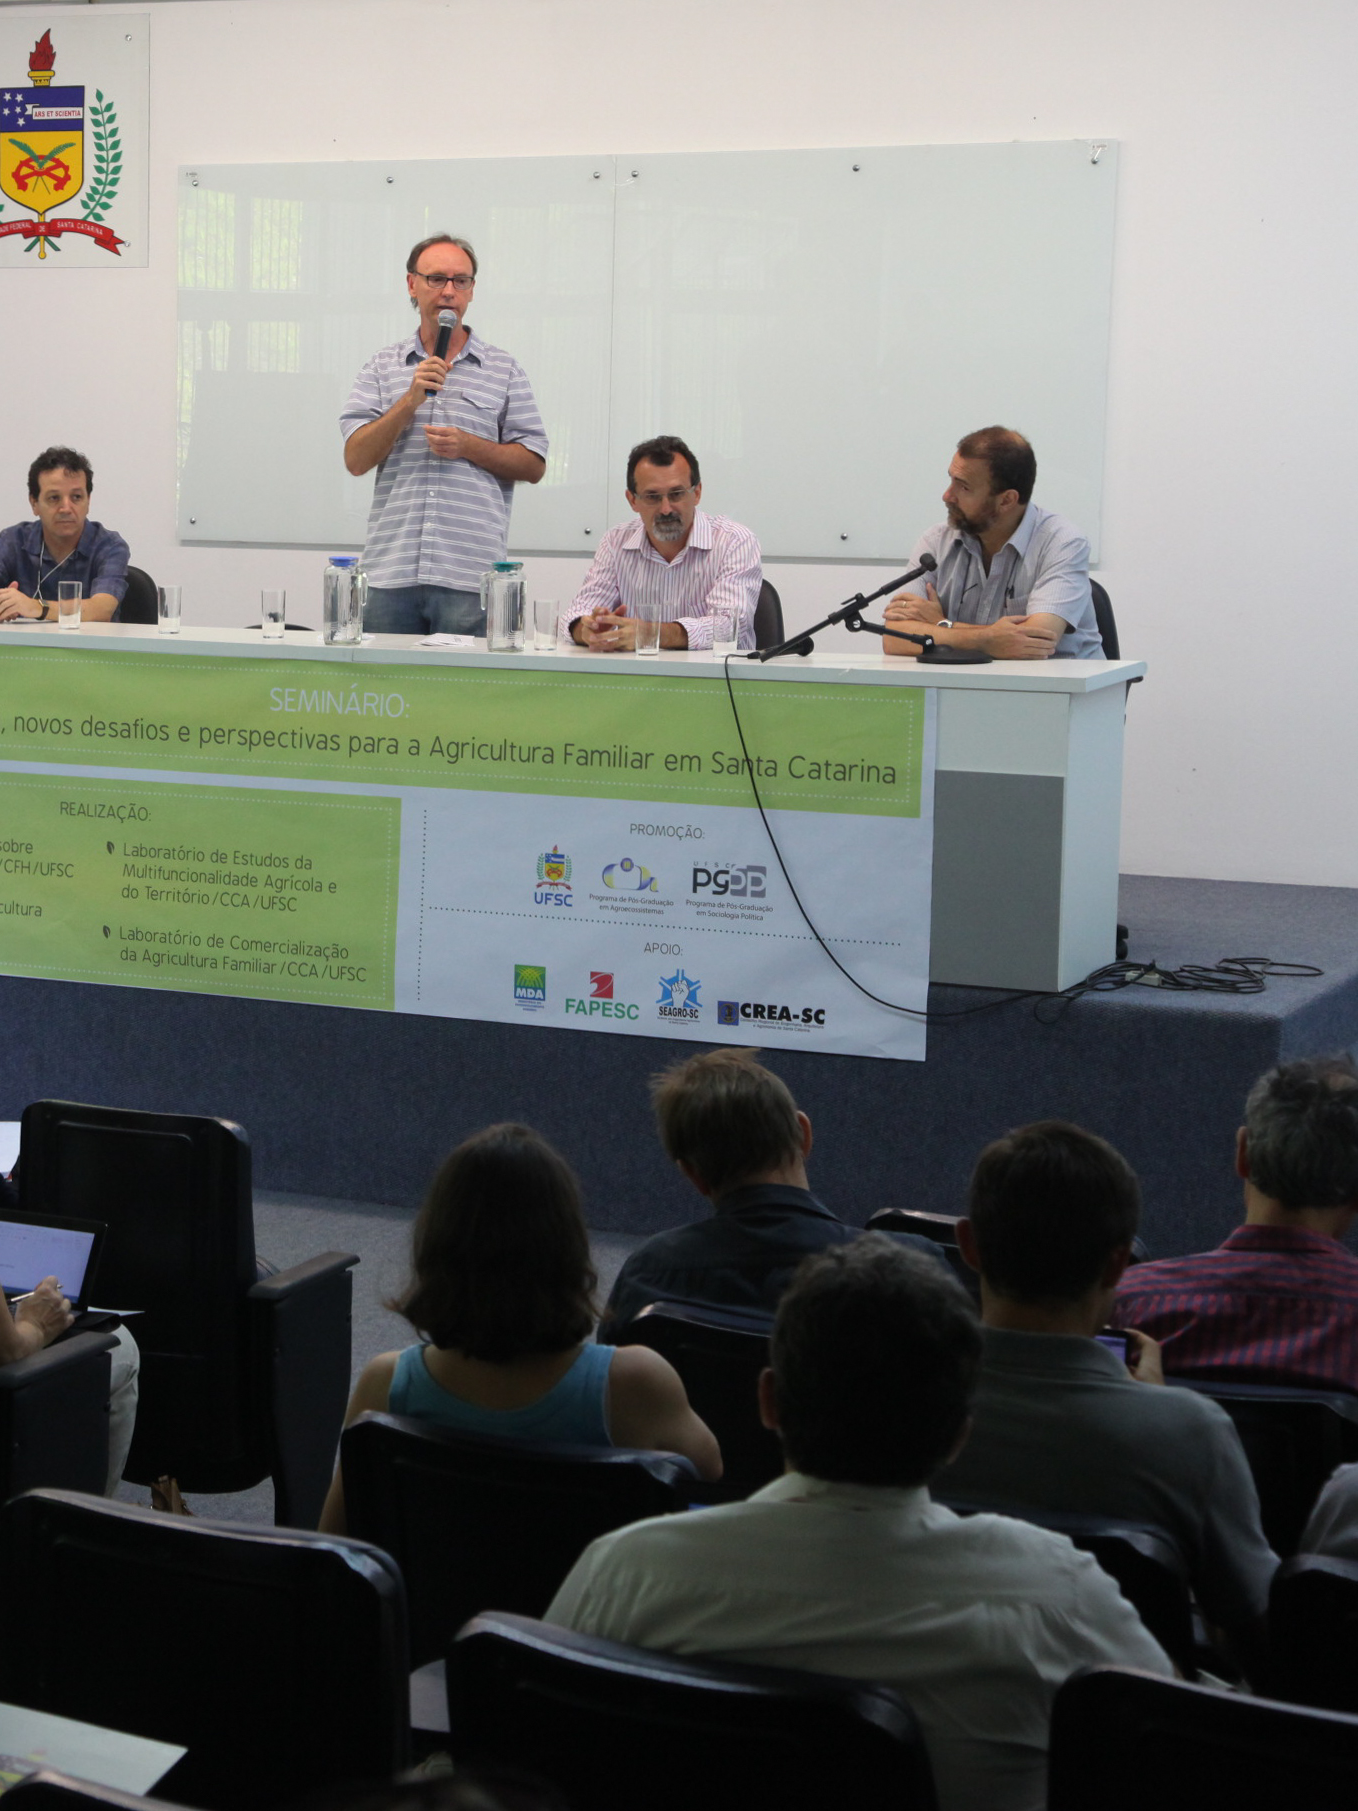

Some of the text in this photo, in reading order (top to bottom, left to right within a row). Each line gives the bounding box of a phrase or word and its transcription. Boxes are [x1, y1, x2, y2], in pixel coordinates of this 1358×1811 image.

[10, 222, 32, 231] FEDERAL
[77, 223, 103, 235] CATARINA
[269, 683, 410, 719] SEMINÁRIO:
[13, 713, 73, 736] novos
[80, 715, 170, 743] desafios
[177, 725, 191, 743] e
[198, 725, 341, 753] perspectivas
[348, 732, 400, 758] para
[408, 738, 421, 757] a
[430, 735, 555, 766] Agricultura
[564, 742, 655, 770] Familiar
[664, 752, 702, 774] em
[711, 750, 778, 779] Santa
[788, 755, 897, 785] Catarina
[59, 801, 152, 823] REALIZAÇÃO:
[630, 823, 705, 841] PROMOÇÃO:
[123, 843, 312, 870] Laboratório de Estudos da
[122, 864, 337, 894] Multifuncionalidade Agrícola e
[122, 885, 139, 899] do
[534, 892, 573, 907] UFSC
[589, 893, 617, 902] Programa
[628, 897, 674, 907] Pós-Graduação
[610, 905, 664, 914] Agroecossistemas
[686, 899, 715, 908] Programa
[726, 903, 773, 912] Pós-Graduação
[708, 910, 739, 920] Sociologia
[741, 912, 763, 920] Política
[119, 926, 349, 960] Laboratório de Comercialização
[643, 941, 683, 956] APOIO:
[120, 948, 137, 962] da
[142, 949, 218, 969] Agricultura
[516, 988, 544, 999] MDA
[566, 998, 639, 1020] FAPESC
[659, 1006, 699, 1018] SEAGRO-SC
[740, 1003, 825, 1025] CREA-SC
